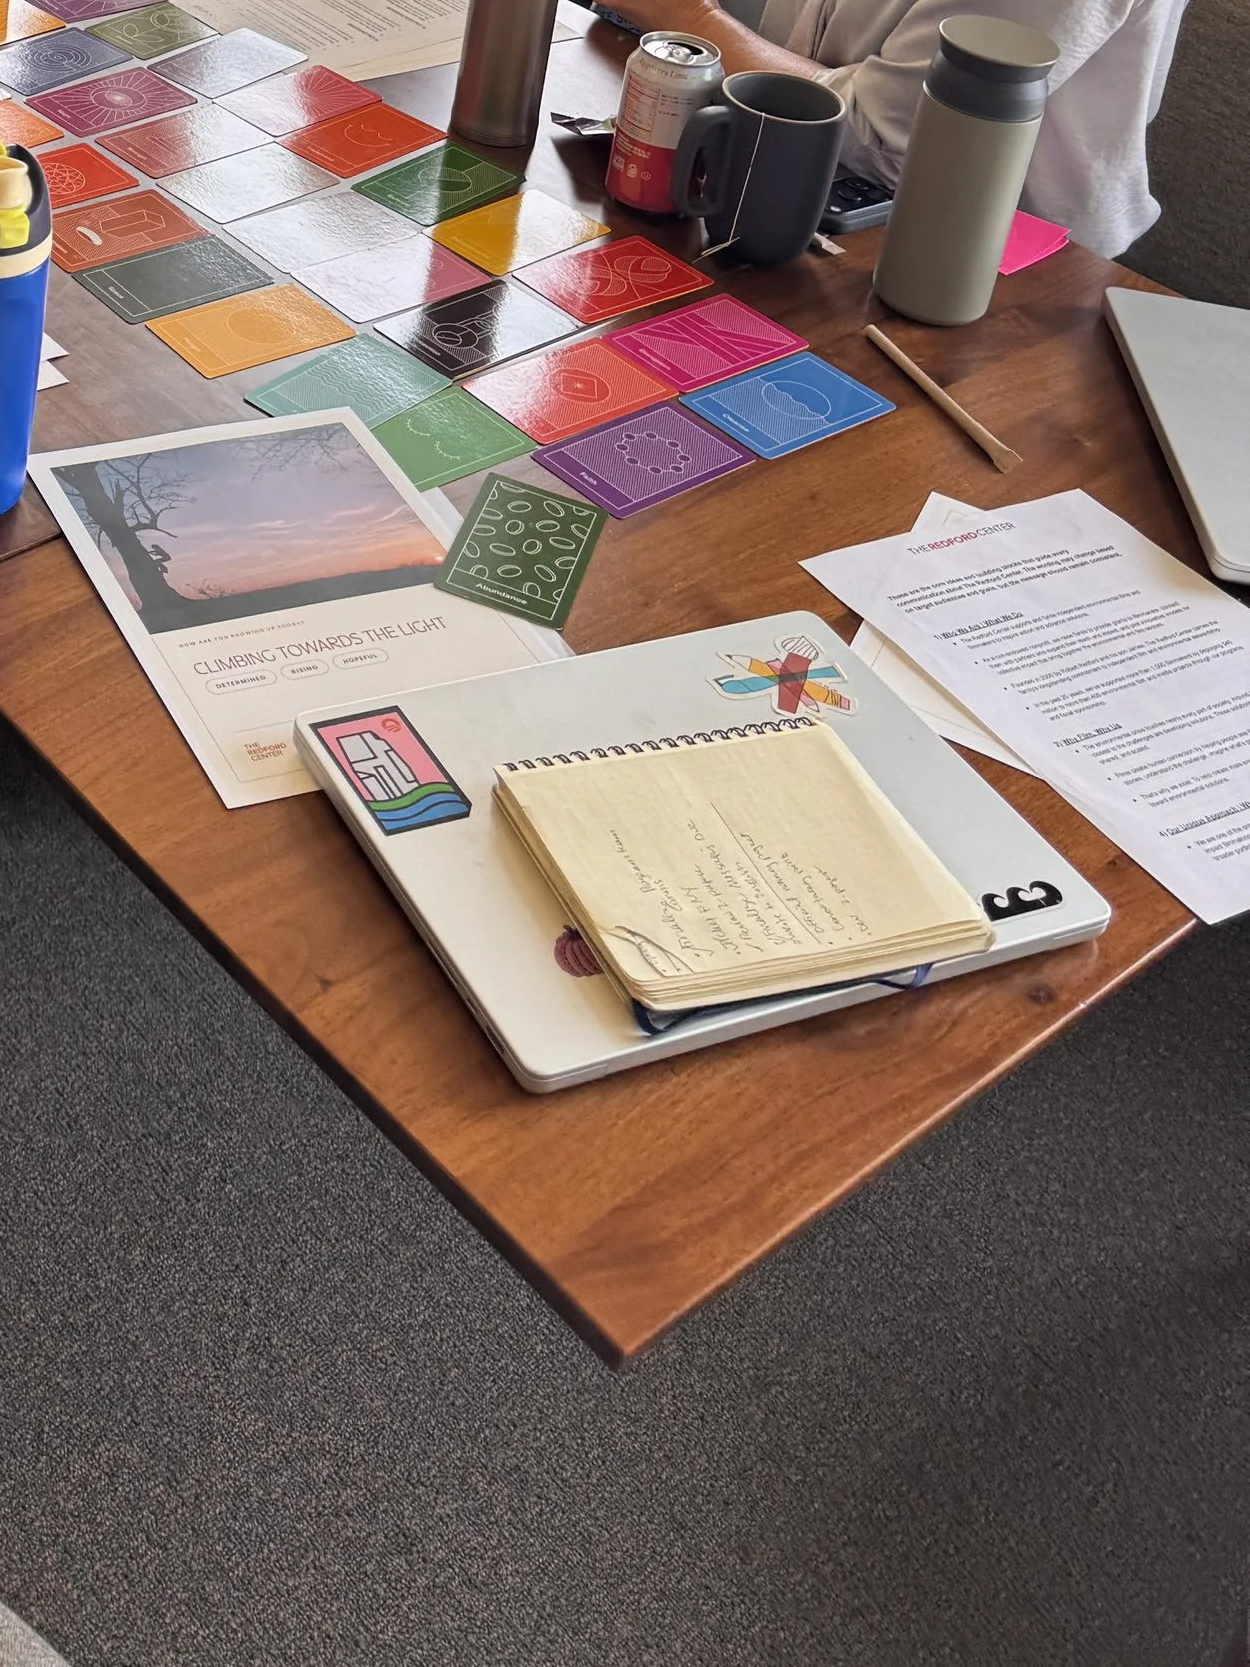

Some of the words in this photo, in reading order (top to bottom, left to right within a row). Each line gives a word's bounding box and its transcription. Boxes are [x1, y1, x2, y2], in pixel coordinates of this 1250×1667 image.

[579, 471, 598, 486] Faith
[475, 581, 528, 606] Abundance
[179, 640, 196, 649] HOW
[194, 648, 277, 675] CLIMBING
[276, 633, 364, 660] TOWARDS
[363, 626, 397, 643] THE
[397, 616, 448, 636] LIGHT
[215, 674, 267, 690] DETERMINED
[290, 664, 319, 675] RISING
[342, 652, 379, 664] HOPEFUL
[244, 742, 260, 750] THE
[247, 743, 287, 755] REDFORD
[251, 750, 283, 762] CENTER
